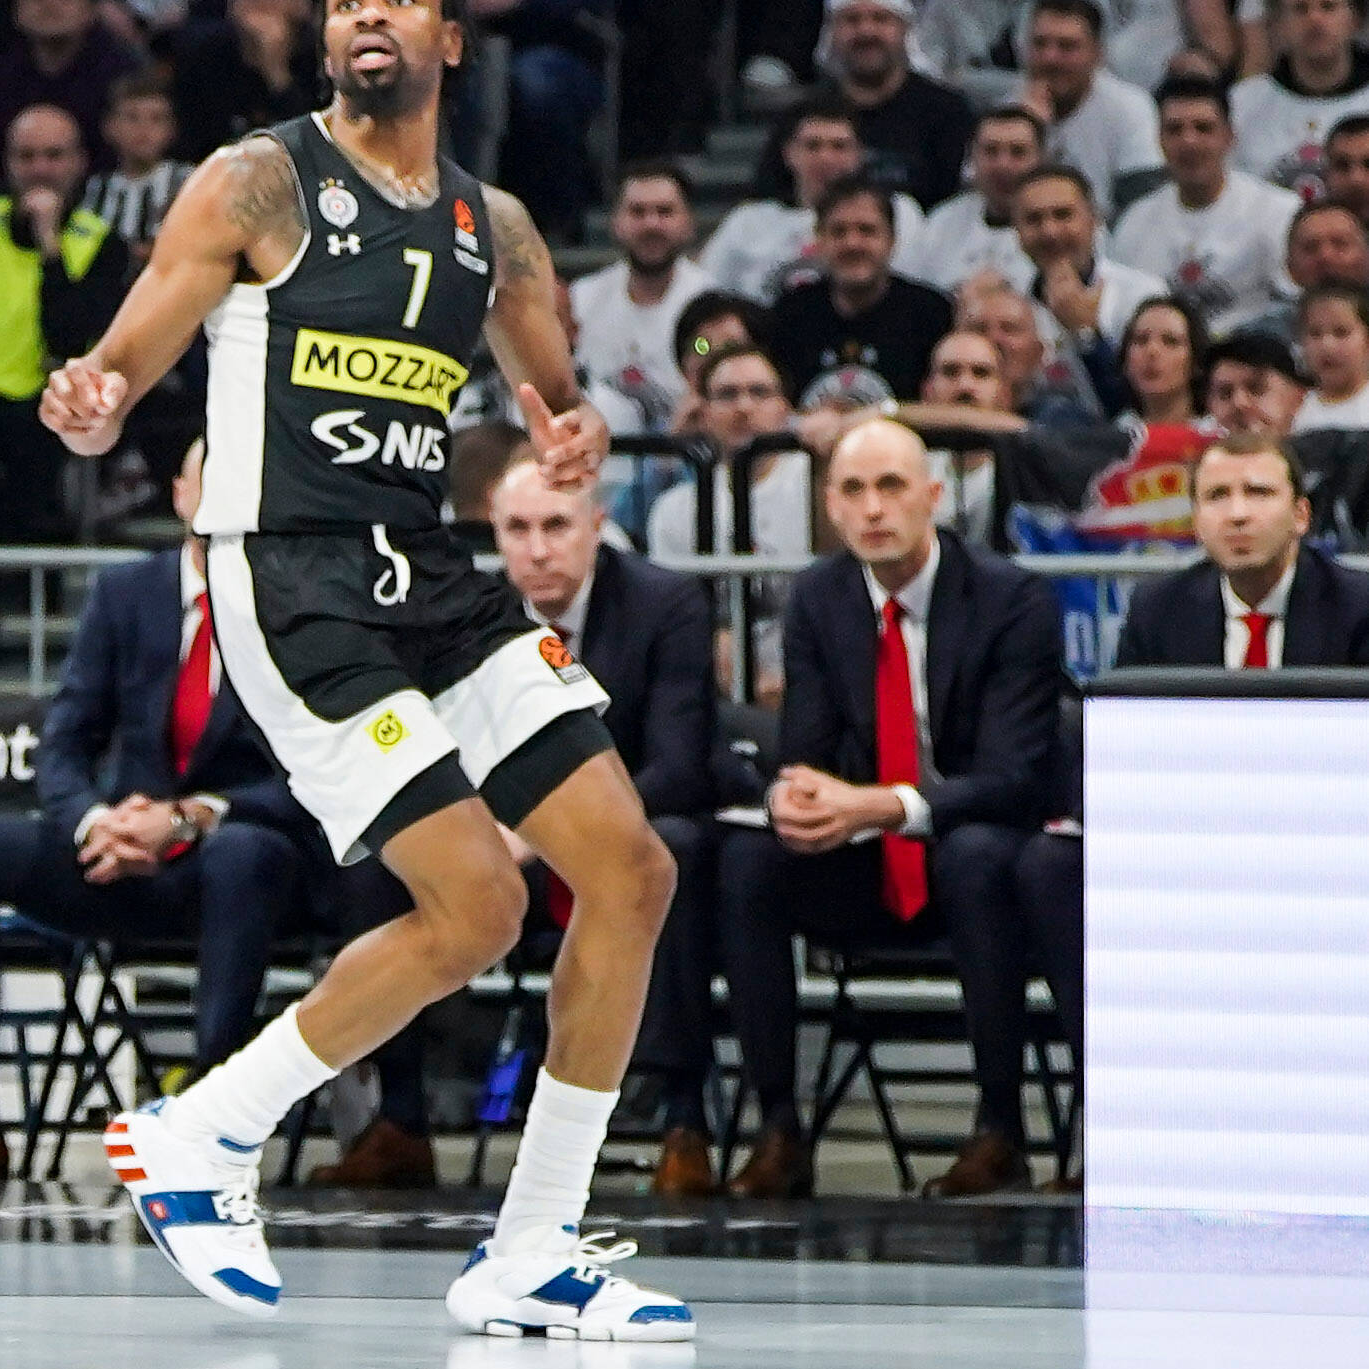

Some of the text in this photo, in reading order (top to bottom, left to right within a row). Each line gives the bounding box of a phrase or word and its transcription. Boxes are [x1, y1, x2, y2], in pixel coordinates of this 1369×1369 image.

[401, 248, 433, 329] 7
[304, 342, 460, 401] MOZZART
[381, 420, 447, 472] NIS
